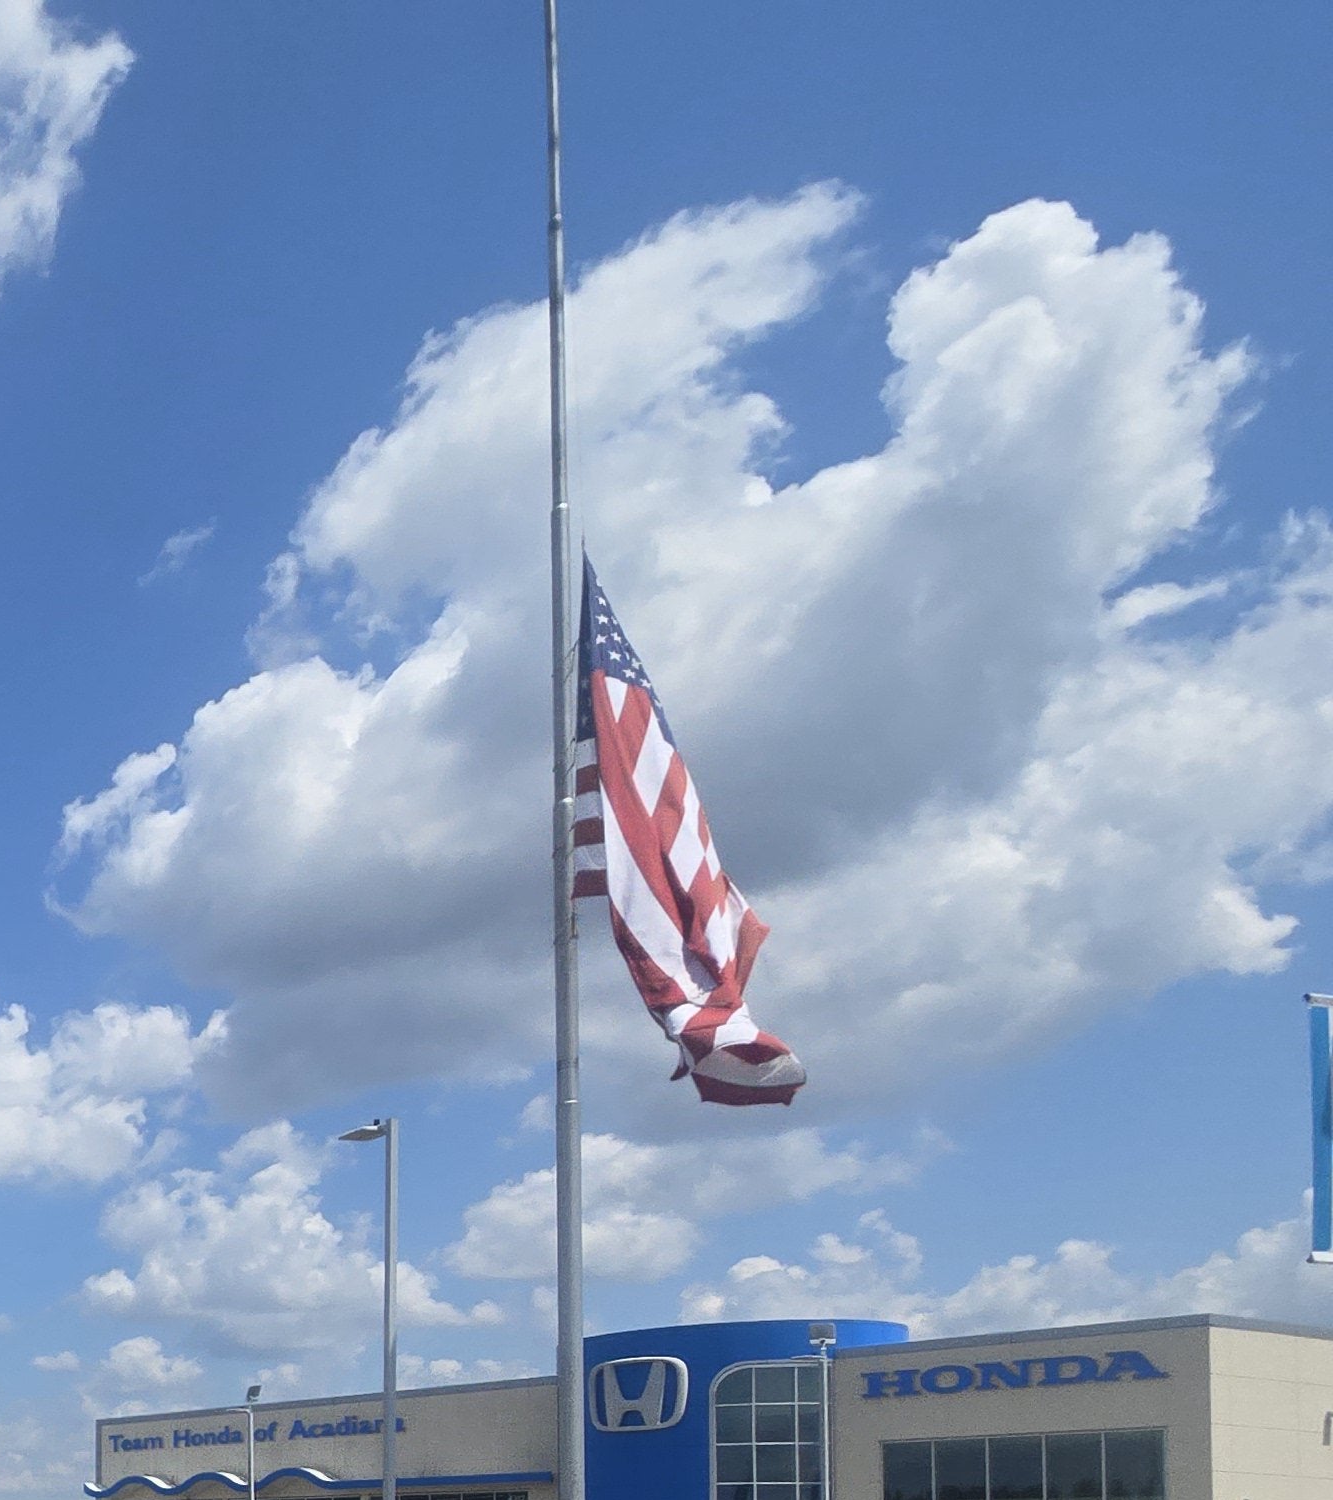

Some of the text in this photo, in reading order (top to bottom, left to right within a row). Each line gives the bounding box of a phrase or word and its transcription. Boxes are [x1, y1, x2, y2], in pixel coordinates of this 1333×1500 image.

[860, 1350, 1170, 1398] HONDA
[108, 1433, 164, 1452] Team
[173, 1425, 243, 1448] Honda
[254, 1421, 278, 1442] of
